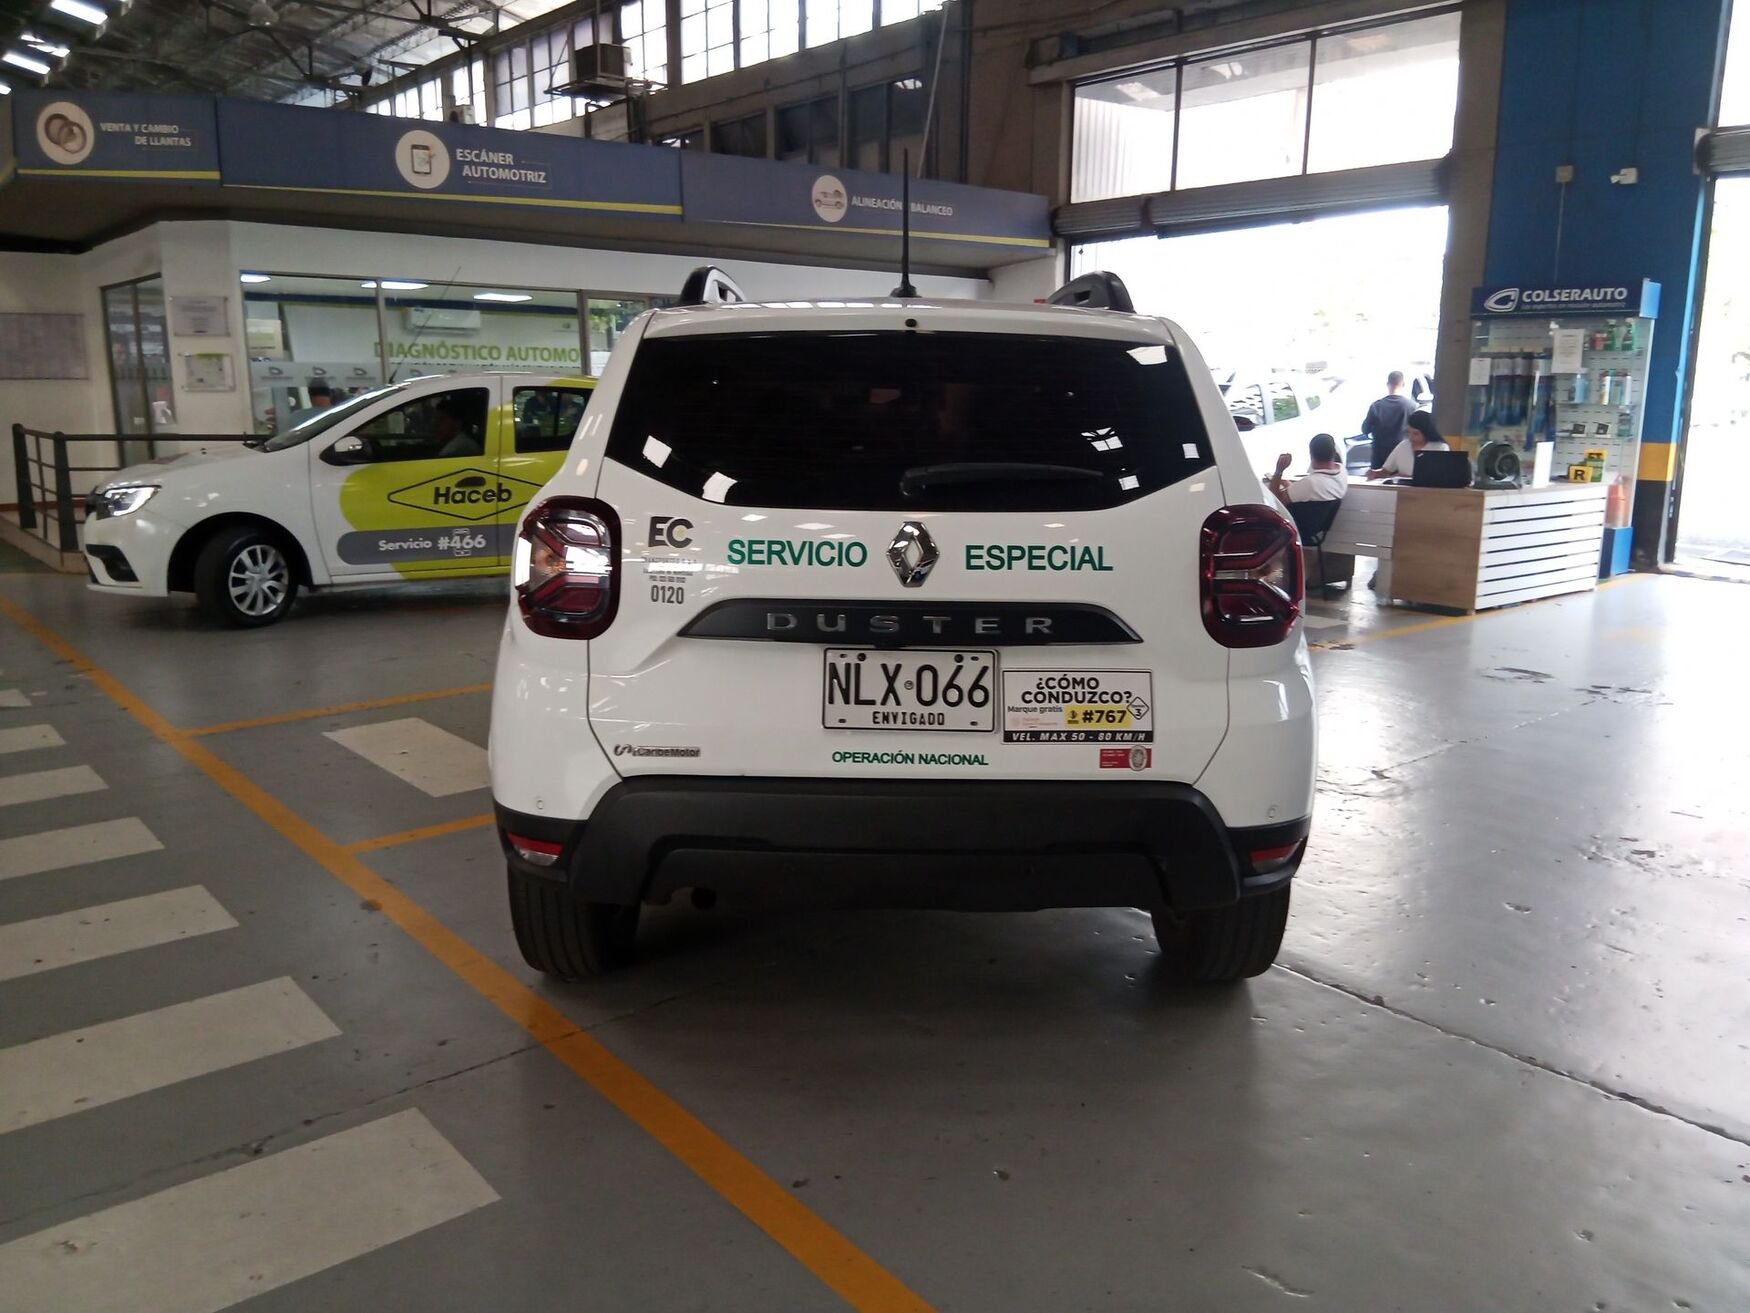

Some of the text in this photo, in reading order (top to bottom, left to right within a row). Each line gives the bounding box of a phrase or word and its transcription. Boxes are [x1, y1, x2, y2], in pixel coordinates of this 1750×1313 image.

[100, 122, 179, 133] VENTA Y CAMBIO
[134, 135, 192, 146] DE LLANTAS
[455, 148, 514, 165] ESCÁNER
[462, 165, 547, 183] AUTOMOTRIZ
[851, 195, 953, 216] ALINEACIÓN BALANCEO
[1522, 287, 1628, 302] COLSERAUTO
[433, 483, 512, 505] Haceb
[648, 516, 694, 548] EC
[378, 534, 486, 551] Servicio #466
[727, 539, 1113, 571] SERVICIO ESPECIAL
[651, 585, 684, 604] 0120
[766, 612, 1053, 634] DUSTER
[1036, 674, 1100, 690] ¿CÓMO
[1021, 691, 1133, 704] CONDUZCO?
[1007, 706, 1063, 714] Marque gratis
[1082, 709, 1127, 724] #767
[1135, 708, 1142, 717] 3
[872, 711, 945, 726] ENVIGADO
[1012, 732, 1036, 741] VEL.
[1039, 732, 1067, 741] MAX
[1071, 732, 1085, 741] 50
[1097, 732, 1112, 741] 80
[1115, 732, 1146, 741] KM/H
[832, 750, 989, 766] OPERACIÓN NACIONAL
